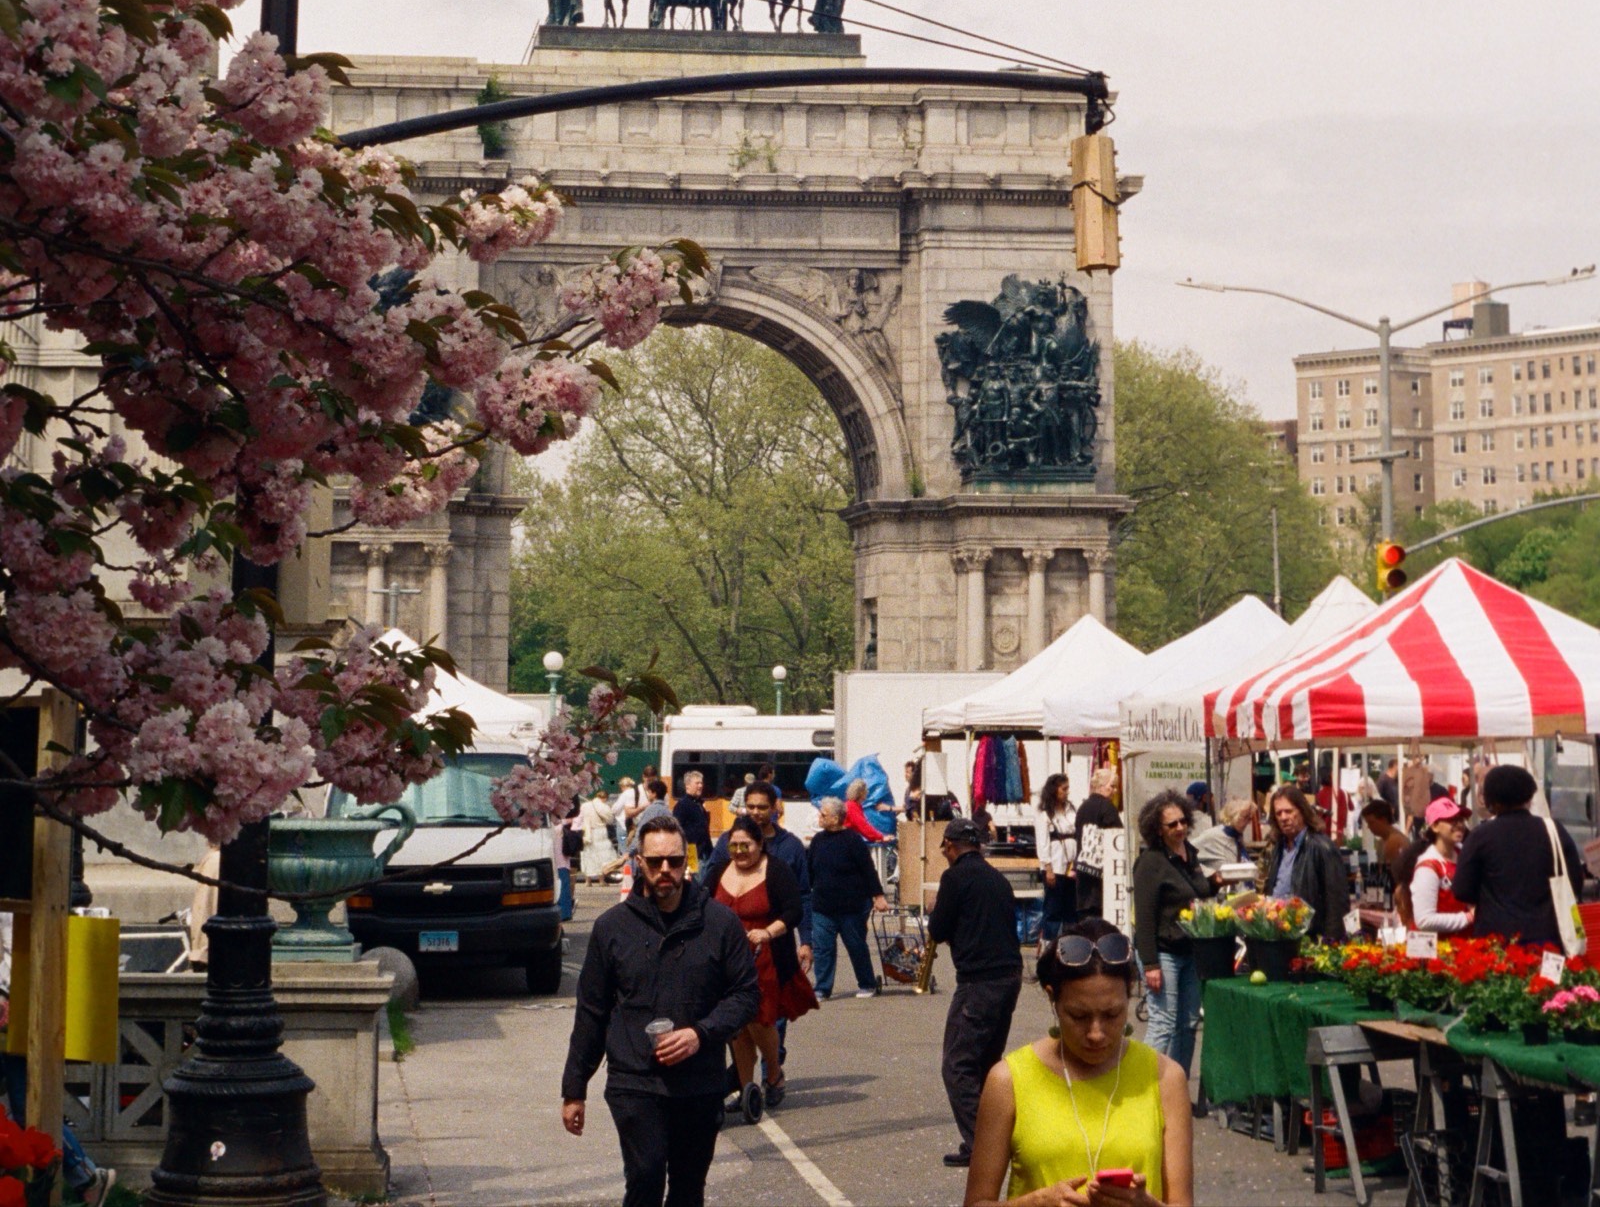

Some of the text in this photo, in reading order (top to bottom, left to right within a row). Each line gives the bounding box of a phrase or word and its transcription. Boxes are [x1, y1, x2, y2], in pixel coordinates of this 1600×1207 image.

[579, 215, 682, 235] DEFENDERS
[1128, 706, 1202, 743] Lost Bread Co.
[1150, 761, 1195, 769] ORGANICALLY
[1145, 771, 1183, 779] FARMSTEAD
